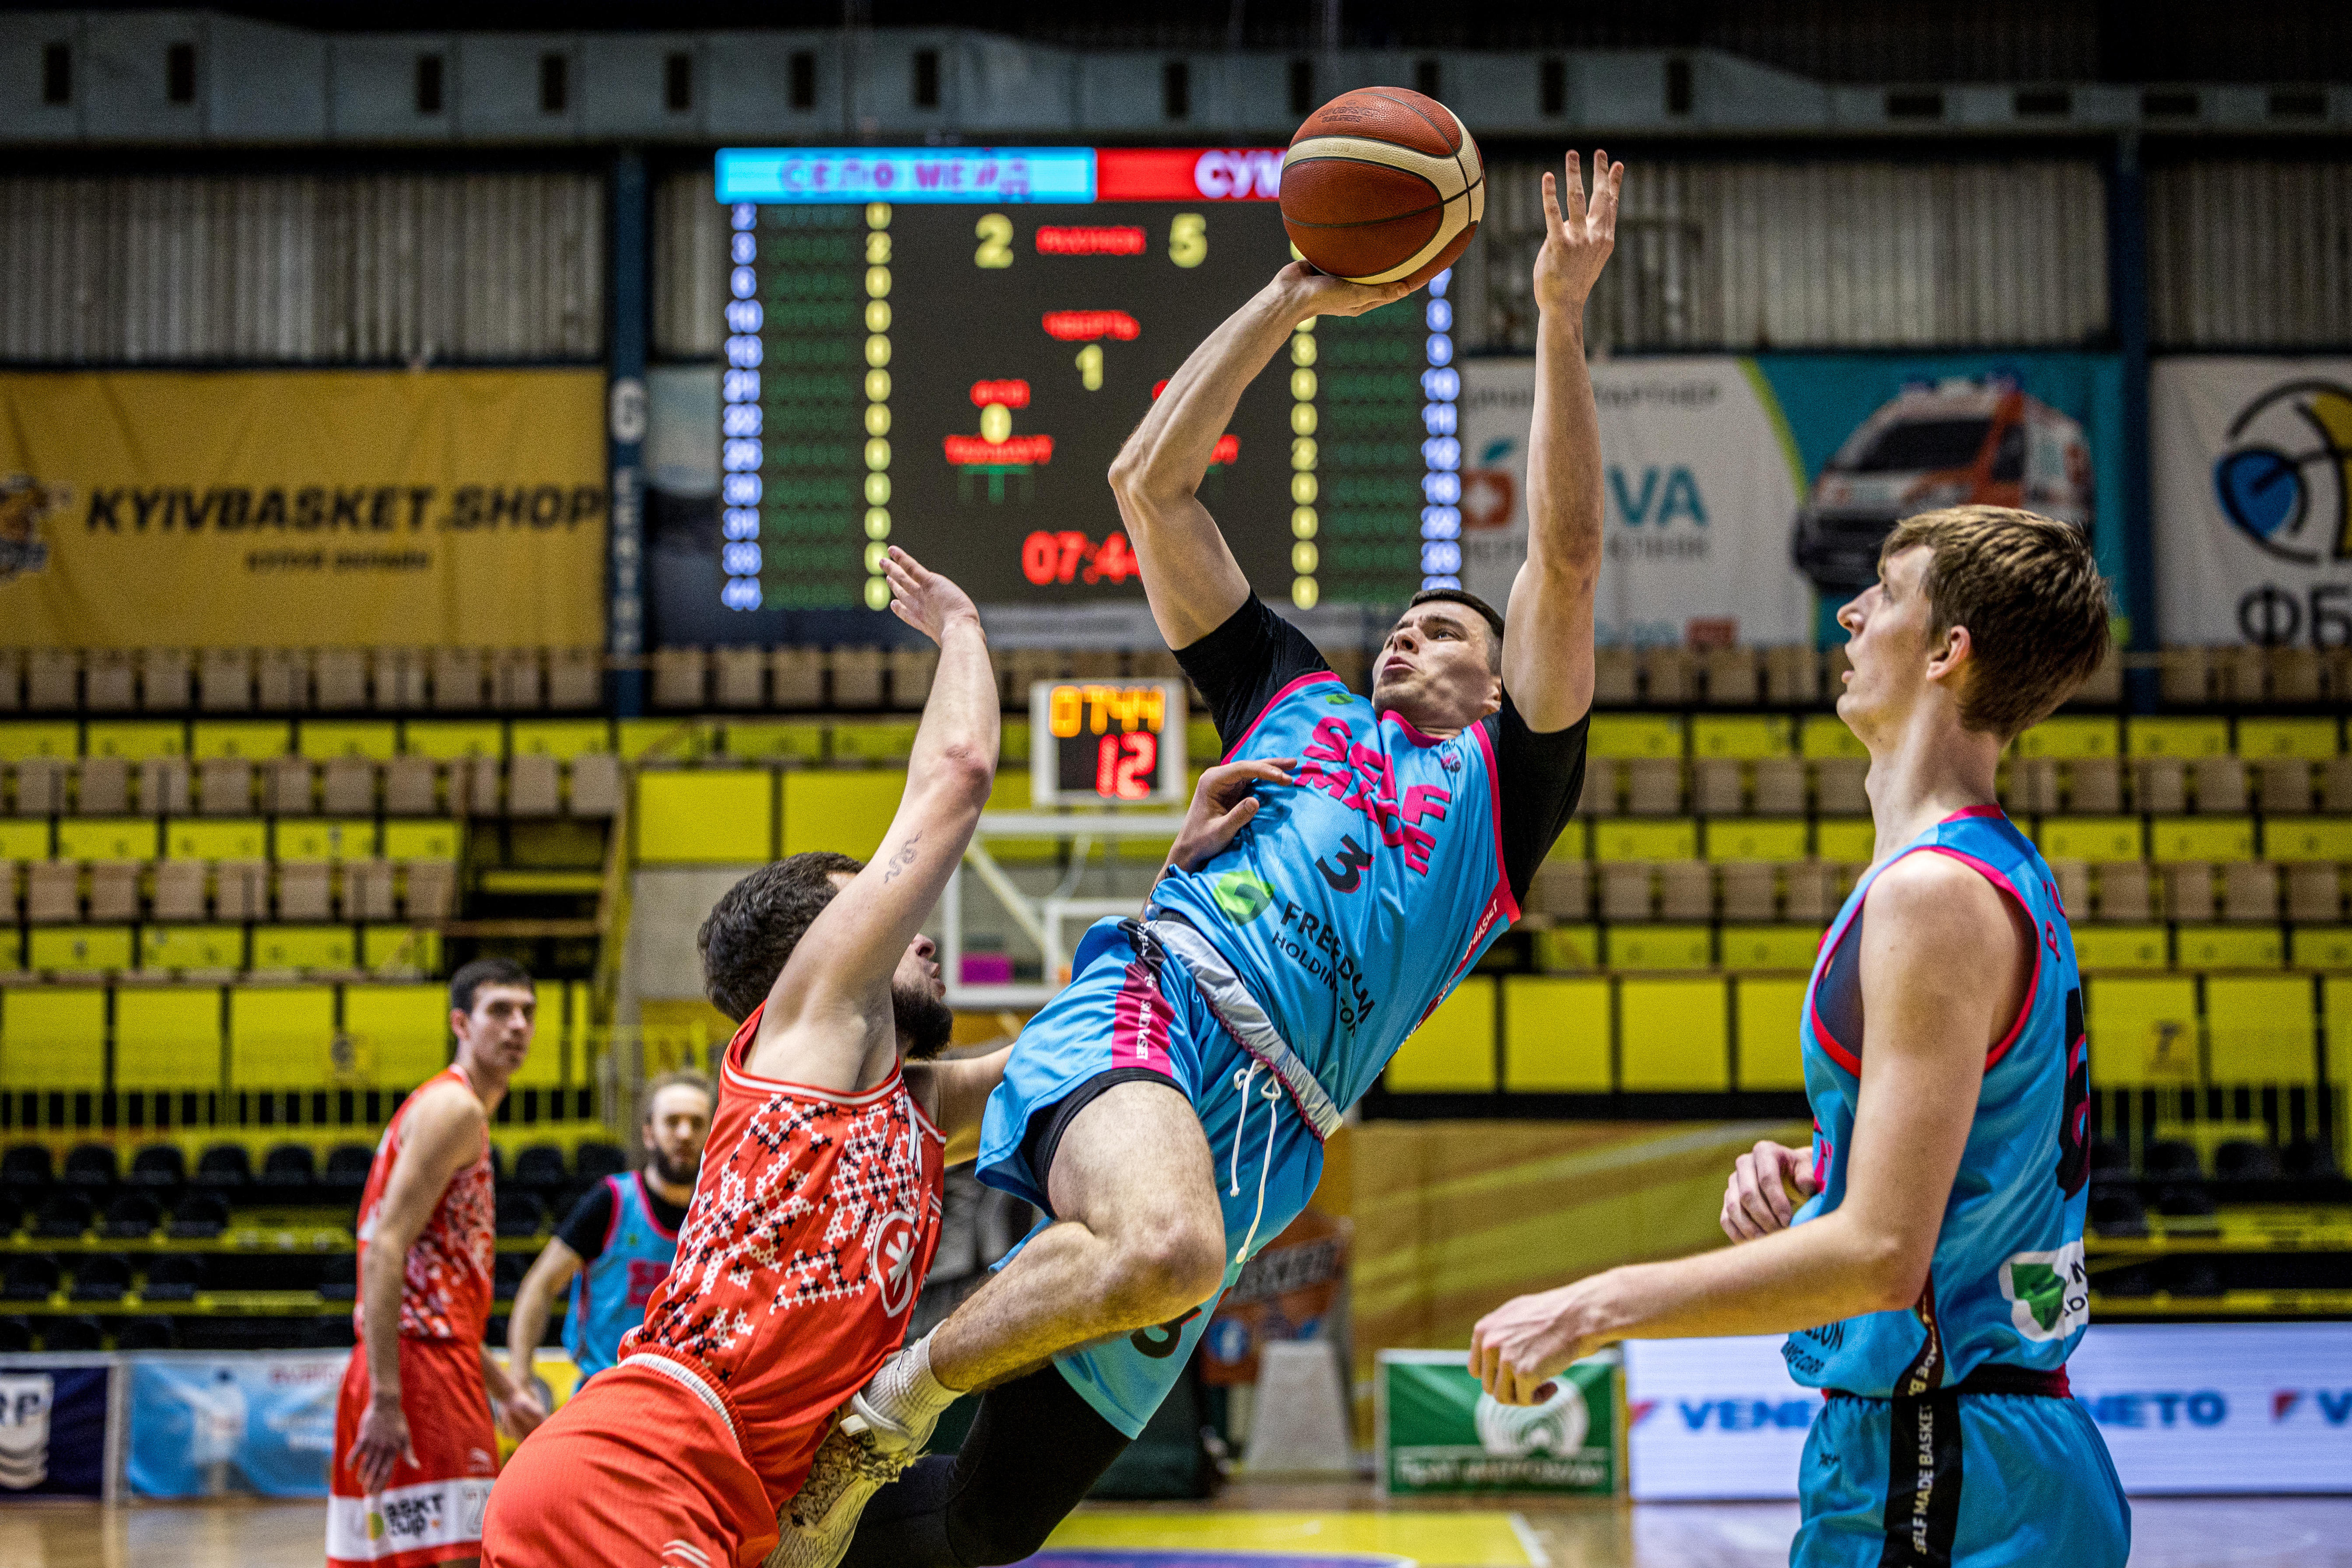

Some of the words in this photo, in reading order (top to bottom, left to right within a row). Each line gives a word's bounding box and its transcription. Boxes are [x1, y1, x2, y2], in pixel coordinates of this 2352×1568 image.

[1194, 150, 1287, 198] СУМ
[975, 213, 1013, 268] 2
[1169, 213, 1207, 268] 5
[1076, 344, 1103, 391] 1
[1609, 466, 1709, 527] VA
[1022, 531, 1141, 585] 07:4
[1096, 731, 1157, 800] 12
[1303, 716, 1451, 826] SELF
[1294, 761, 1437, 876] MADE
[1315, 834, 1375, 893] 3
[1271, 931, 1339, 992] HOLDIN
[1677, 1397, 1822, 1431] VENE
[2073, 1391, 2227, 1428] NETO
[1913, 1469, 1934, 1515] MADE
